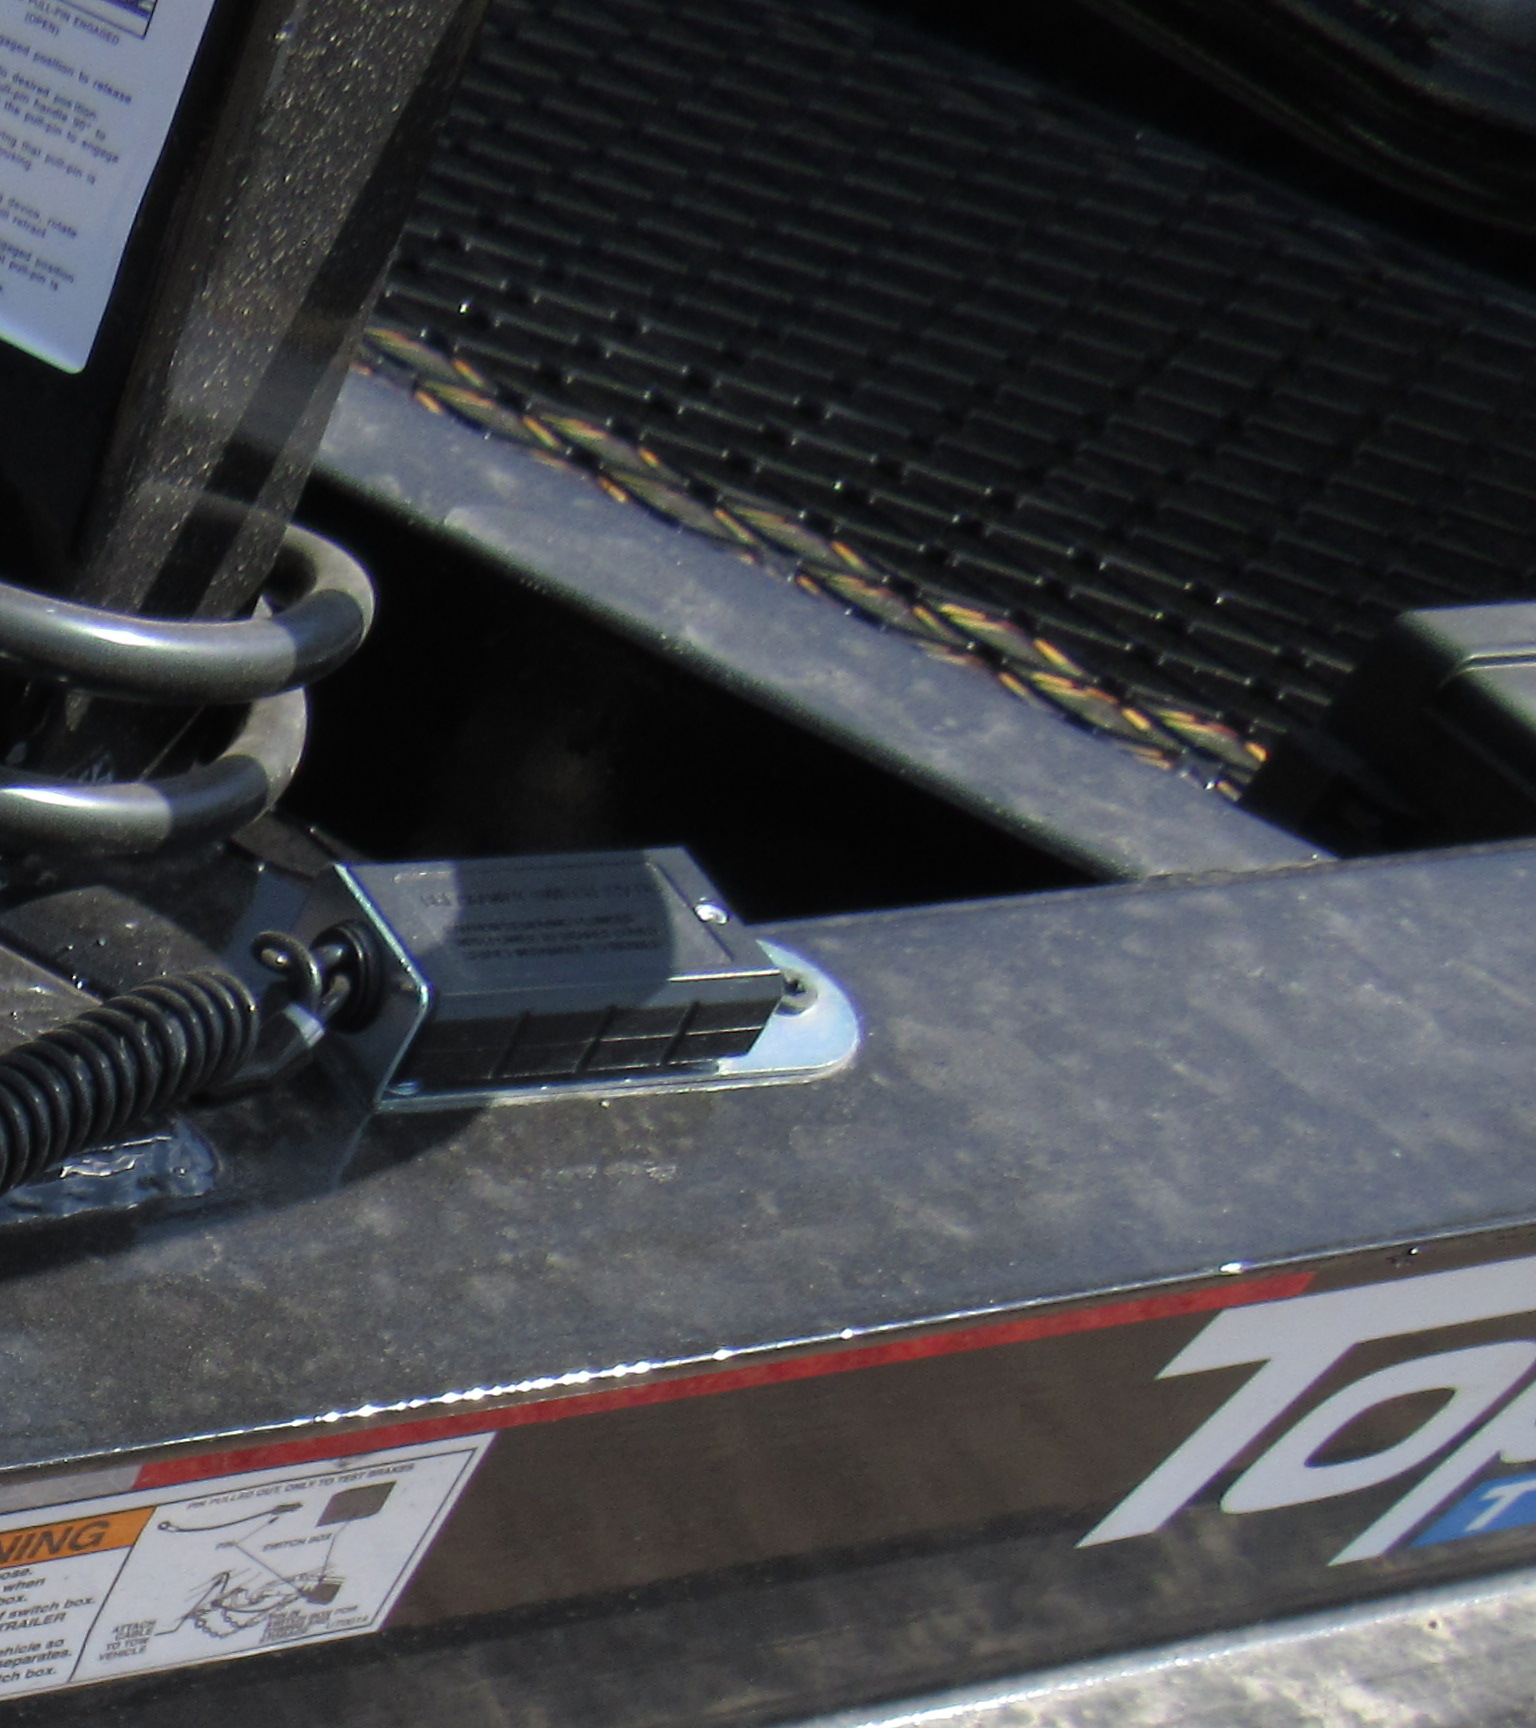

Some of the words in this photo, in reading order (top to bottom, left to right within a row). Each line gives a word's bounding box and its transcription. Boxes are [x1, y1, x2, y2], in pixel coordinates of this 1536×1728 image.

[2, 1577, 46, 1592] when
[8, 1601, 59, 1619] switch
[63, 1597, 96, 1609] box.
[45, 1638, 65, 1649] so
[24, 1667, 57, 1679] box.
